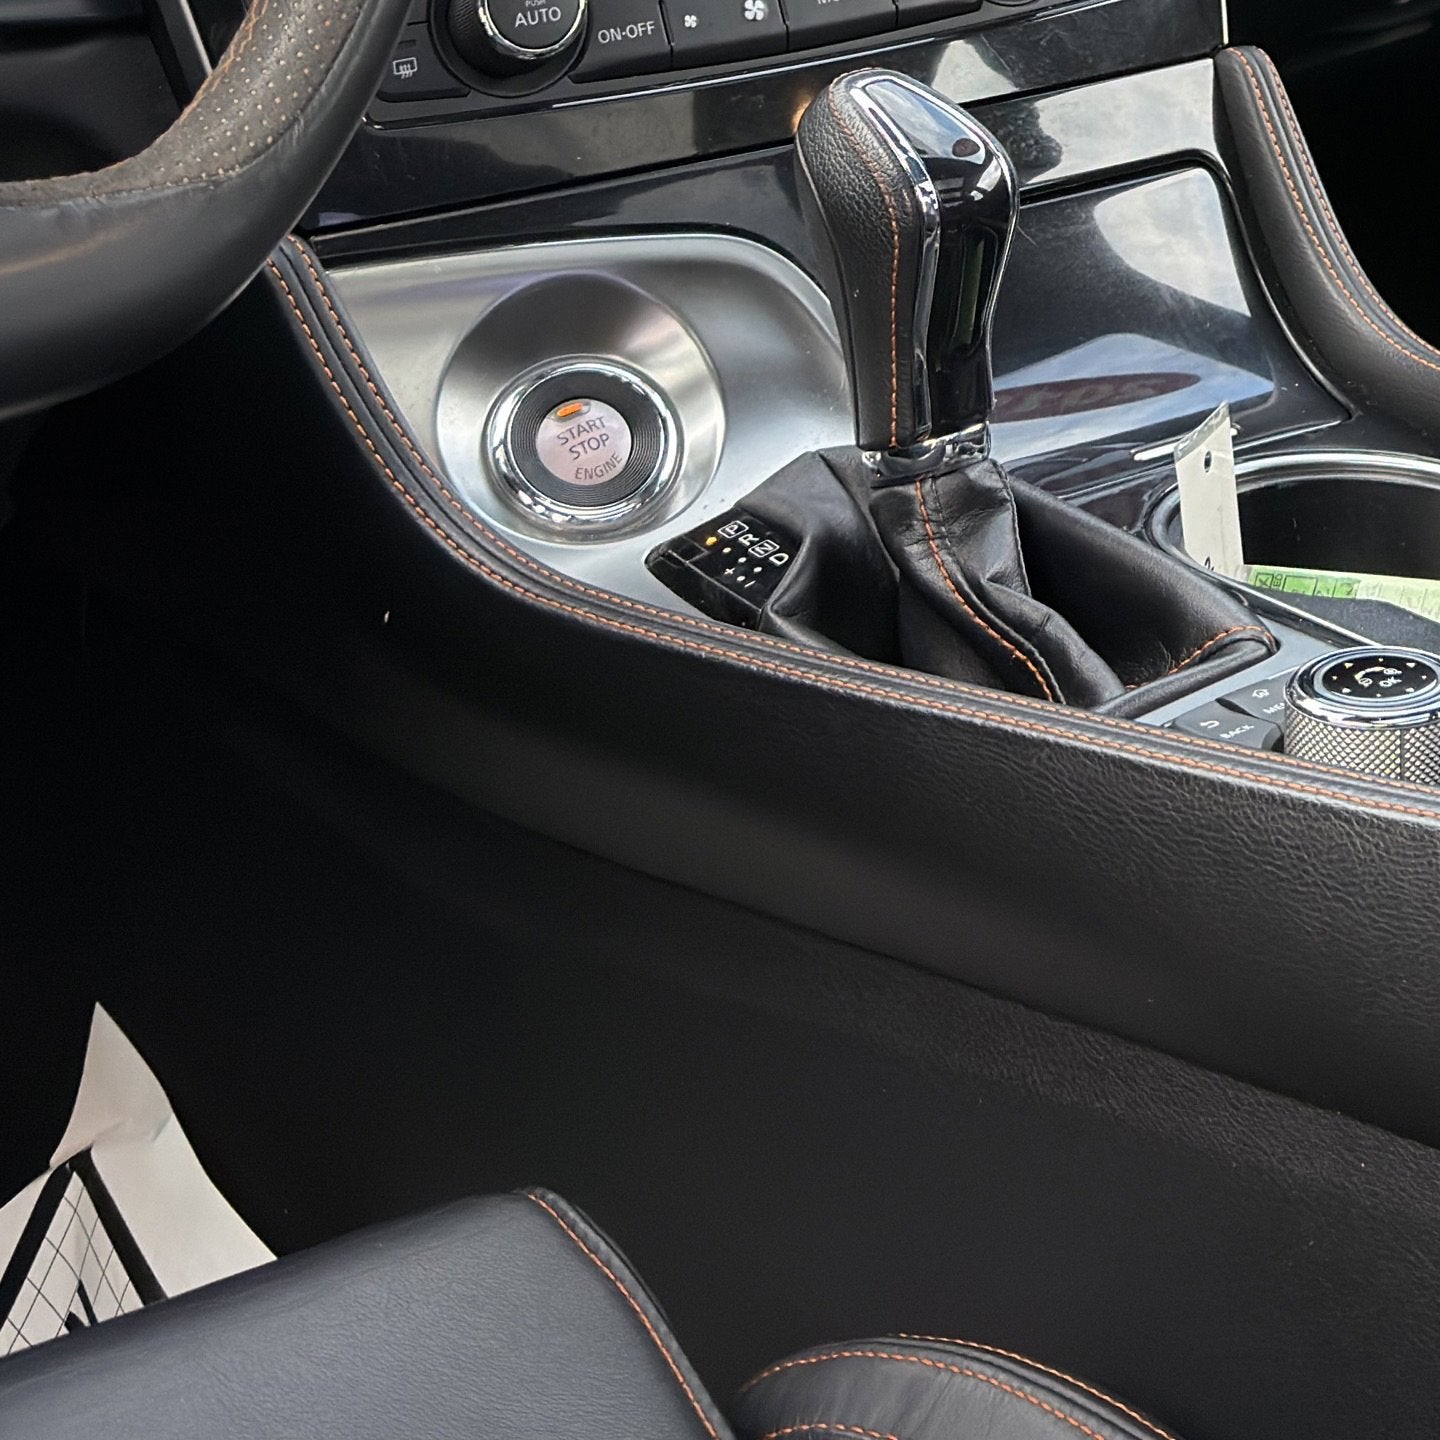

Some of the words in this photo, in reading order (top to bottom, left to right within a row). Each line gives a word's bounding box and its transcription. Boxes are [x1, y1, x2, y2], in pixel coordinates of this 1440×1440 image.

[515, 7, 561, 28] AUTO
[557, 416, 606, 446] START
[569, 432, 610, 461] STOP
[574, 452, 623, 480] ENGINE
[738, 533, 760, 546] R
[769, 552, 789, 566] D
